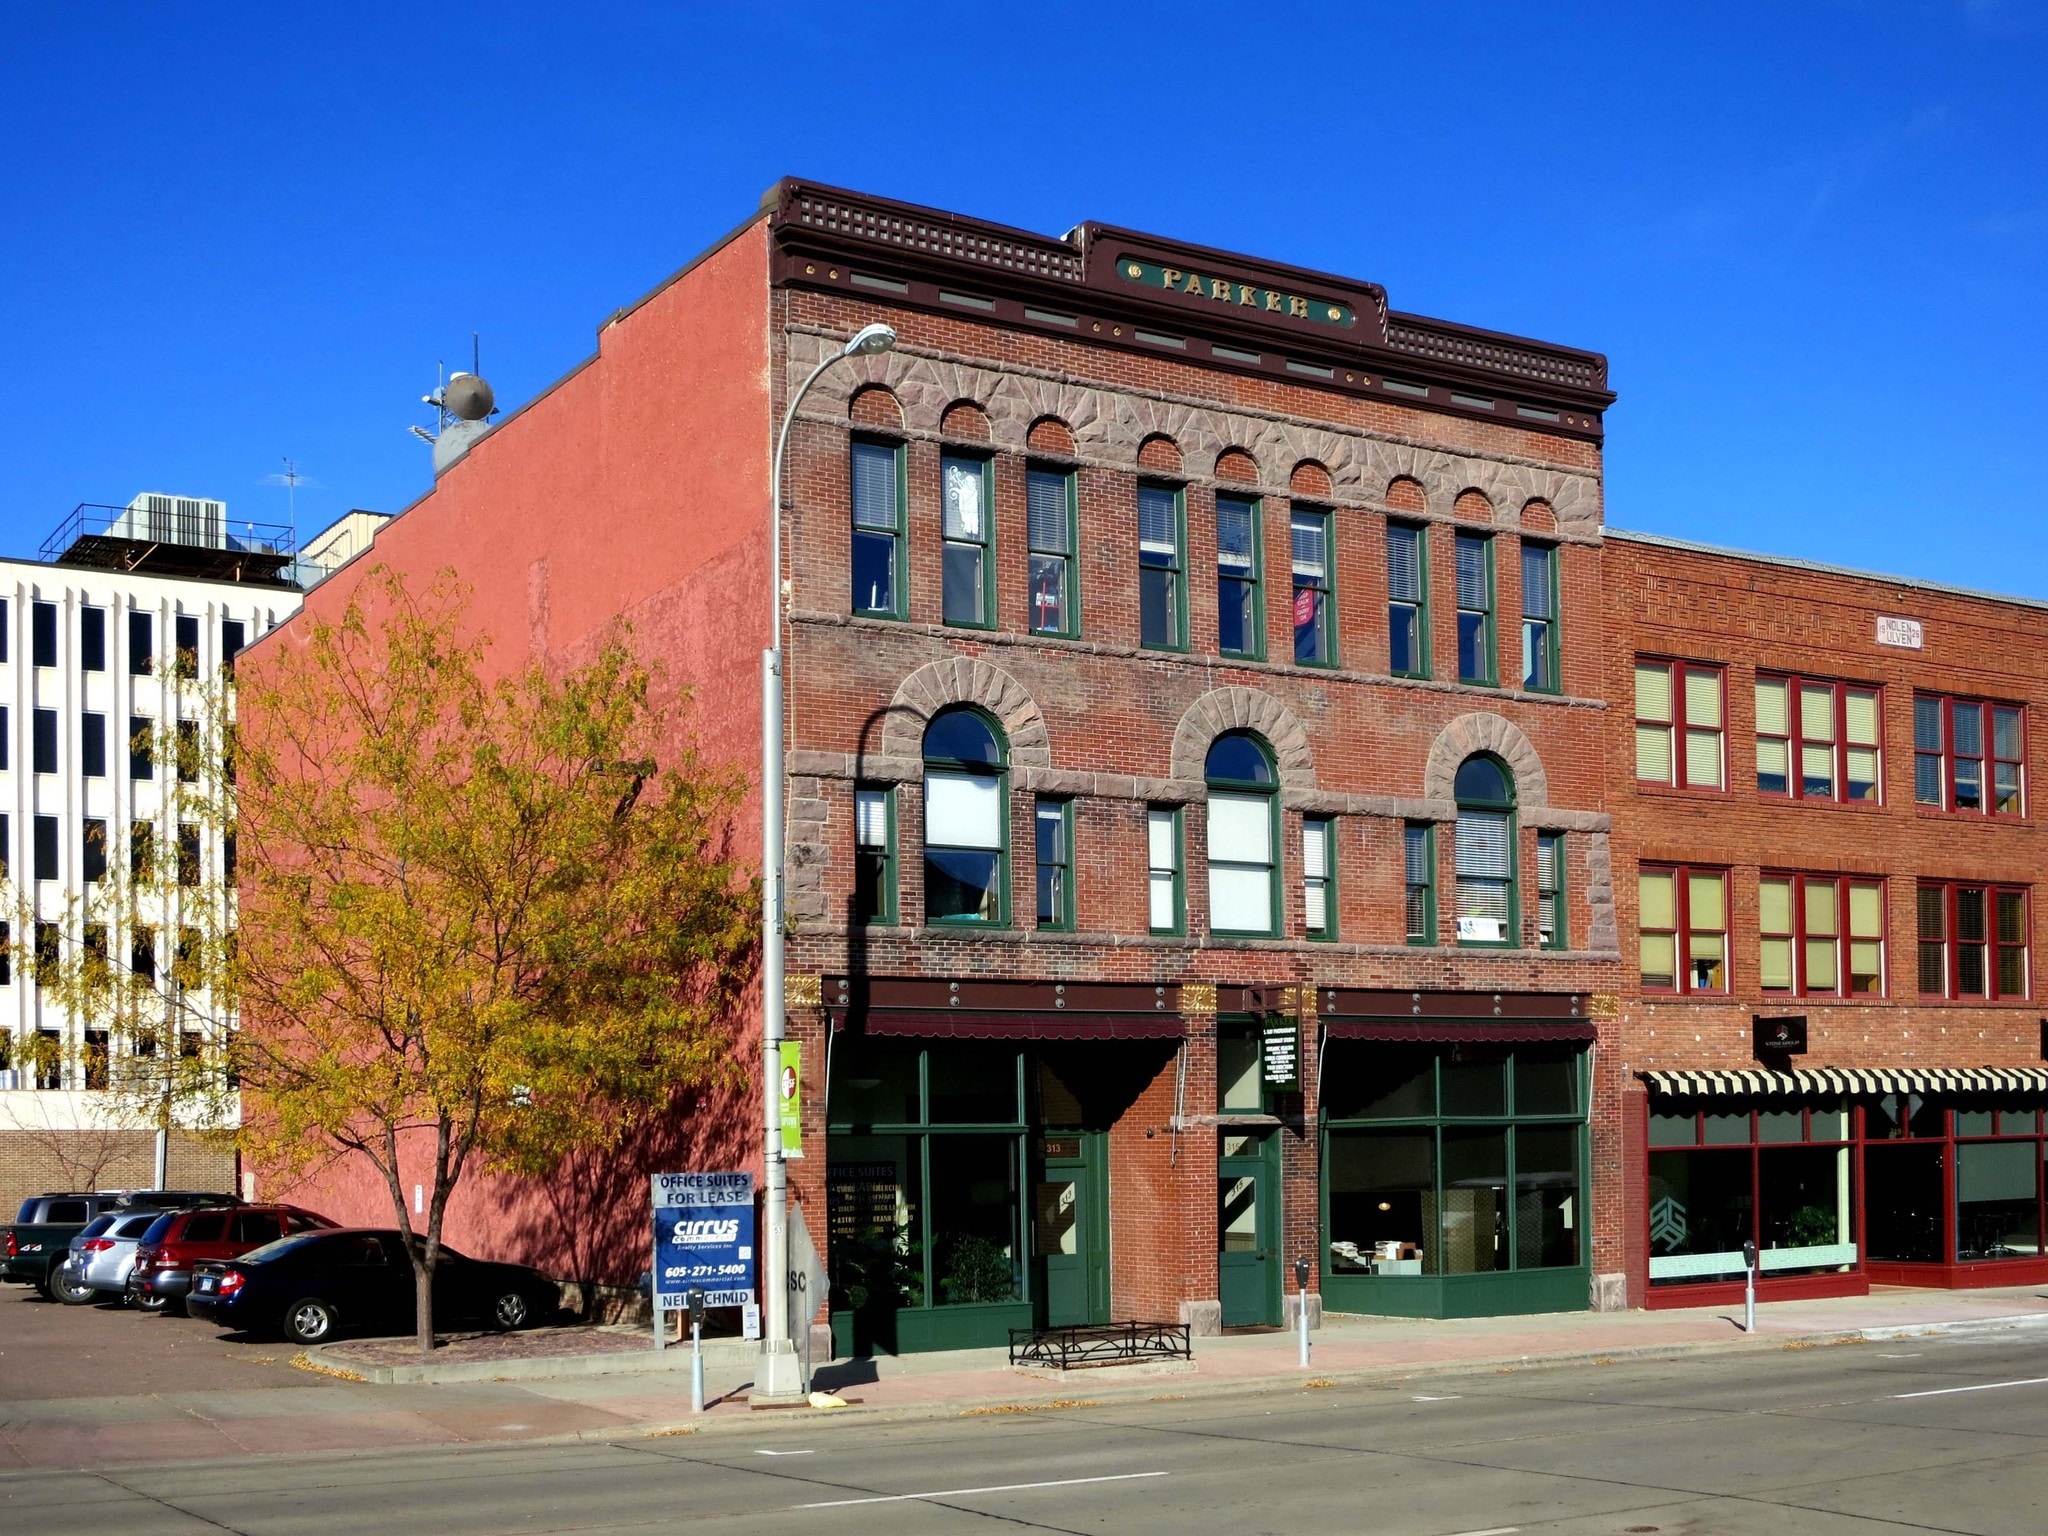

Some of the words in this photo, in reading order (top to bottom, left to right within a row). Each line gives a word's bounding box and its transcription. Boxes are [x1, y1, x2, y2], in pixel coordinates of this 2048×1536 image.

[1162, 267, 1309, 319] PARKER
[1886, 619, 1912, 633] NOLEN
[1046, 1144, 1061, 1153] 313
[1226, 1143, 1240, 1152] 315
[660, 1175, 703, 1189] OFFICE
[706, 1174, 748, 1187] SUITES
[667, 1192, 696, 1205] FOR
[700, 1191, 743, 1203] LEASE
[704, 1292, 749, 1305] CHMID
